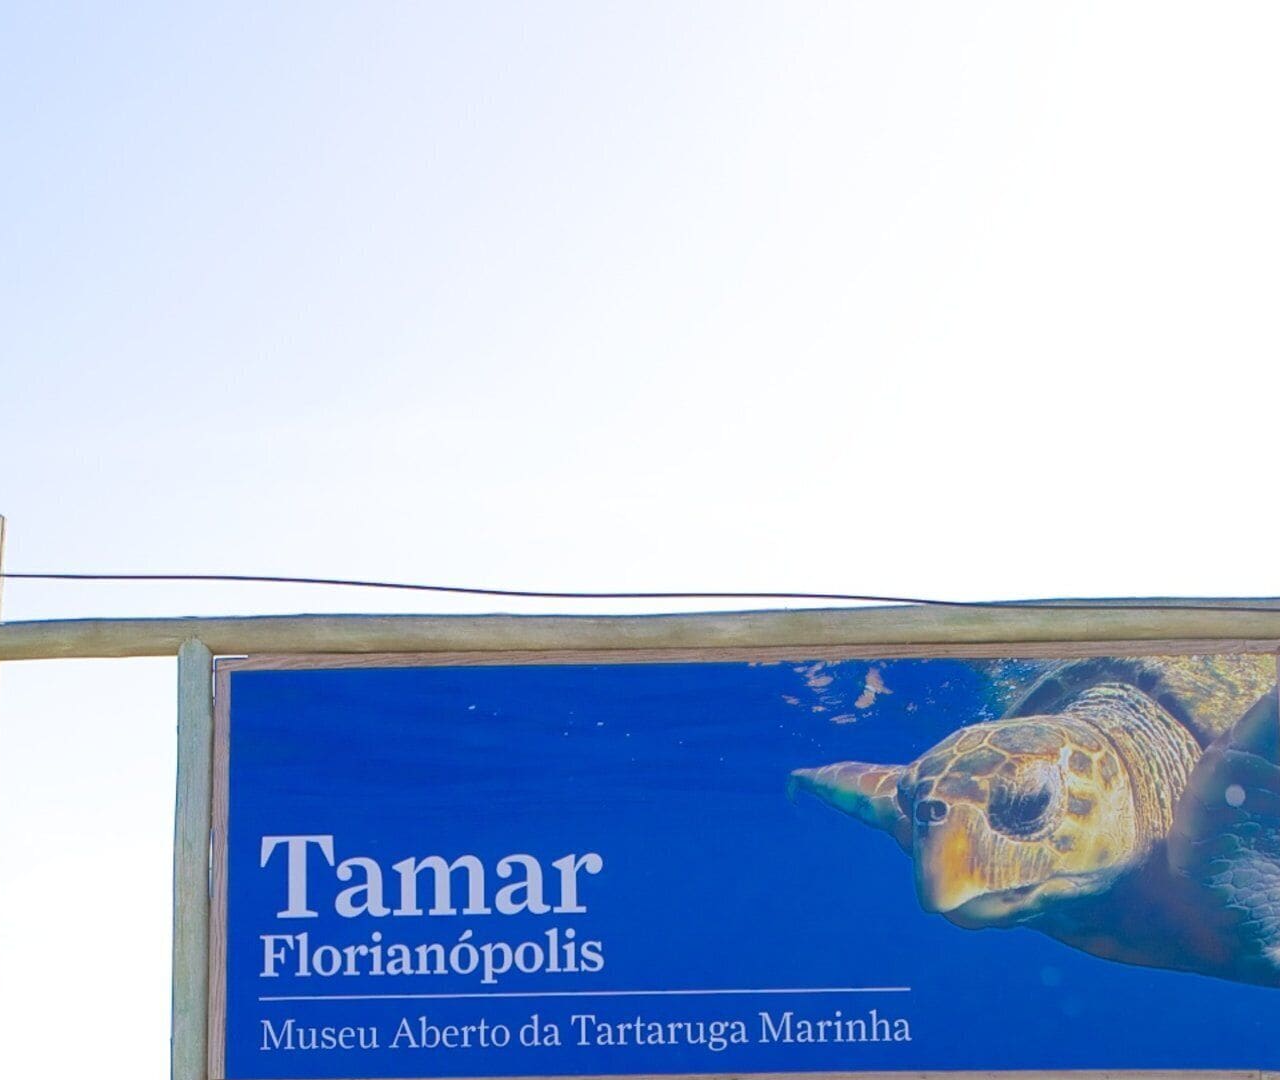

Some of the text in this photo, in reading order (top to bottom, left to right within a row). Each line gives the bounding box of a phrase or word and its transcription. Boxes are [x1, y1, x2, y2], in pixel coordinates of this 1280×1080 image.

[260, 834, 604, 919] Tamar
[260, 928, 605, 984] Florianópolis
[260, 1008, 913, 1052] Museu Aberto da Tartaruga Marinha
